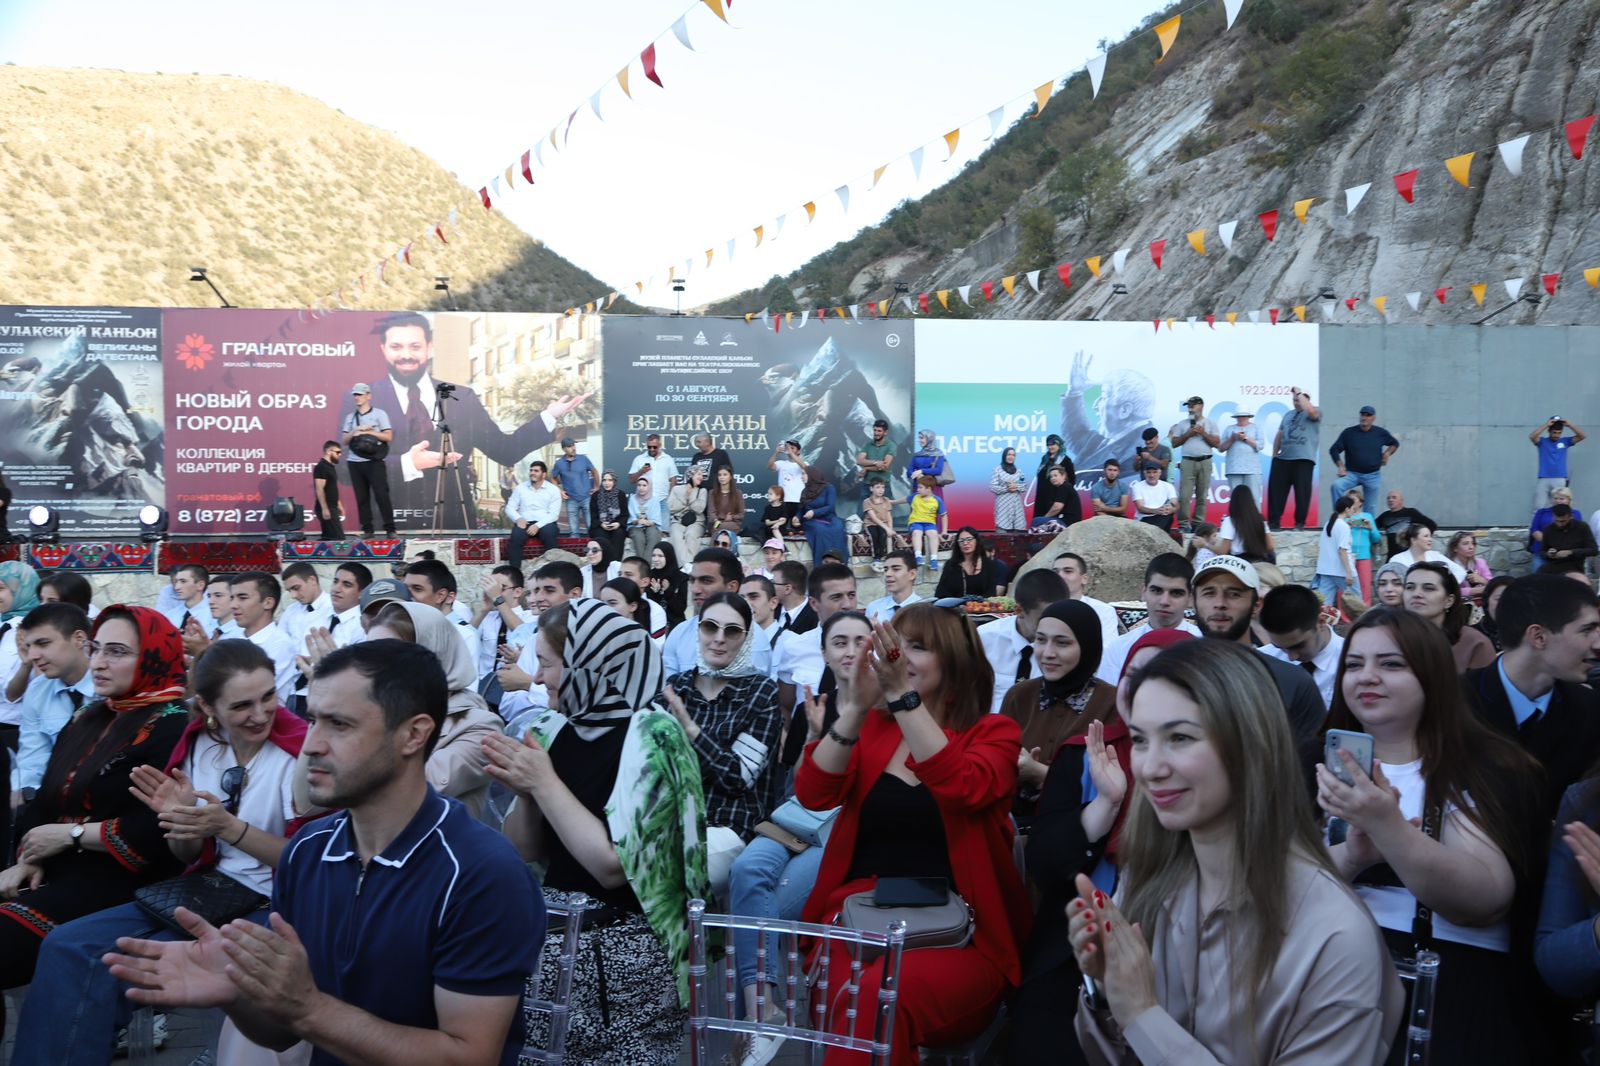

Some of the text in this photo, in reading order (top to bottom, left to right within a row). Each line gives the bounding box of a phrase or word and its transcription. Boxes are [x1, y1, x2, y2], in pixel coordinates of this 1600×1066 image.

[0, 324, 158, 339] УЛАКСКИЙ КАНЬОН
[88, 343, 157, 352] ВЕЛИКАНЫ
[221, 341, 356, 357] ГРАНАТОВЫЙ
[86, 353, 159, 362] ДАГЕСТАНА
[666, 385, 674, 393] С
[682, 385, 727, 393] АВГУСТА
[1240, 385, 1293, 396] 1923-202
[175, 390, 328, 409] НОВЫЙ ОБРАЗ
[655, 394, 739, 403] ПО 30 СЕНТЯБРЯ
[175, 415, 264, 433] ГОРОДА
[627, 414, 768, 432] ВЕЛИКАНЫ
[994, 410, 1047, 432] МОЙ
[934, 436, 1047, 455] ДАГЕСТАН
[176, 448, 265, 460] КОЛЛЕКЦИЯ
[176, 462, 241, 473] КВАРТИР
[244, 463, 255, 473] В
[178, 509, 192, 522] 8
[195, 508, 241, 523] (872)
[392, 509, 437, 518] FFEC
[1201, 557, 1247, 572] BROOKLYN
